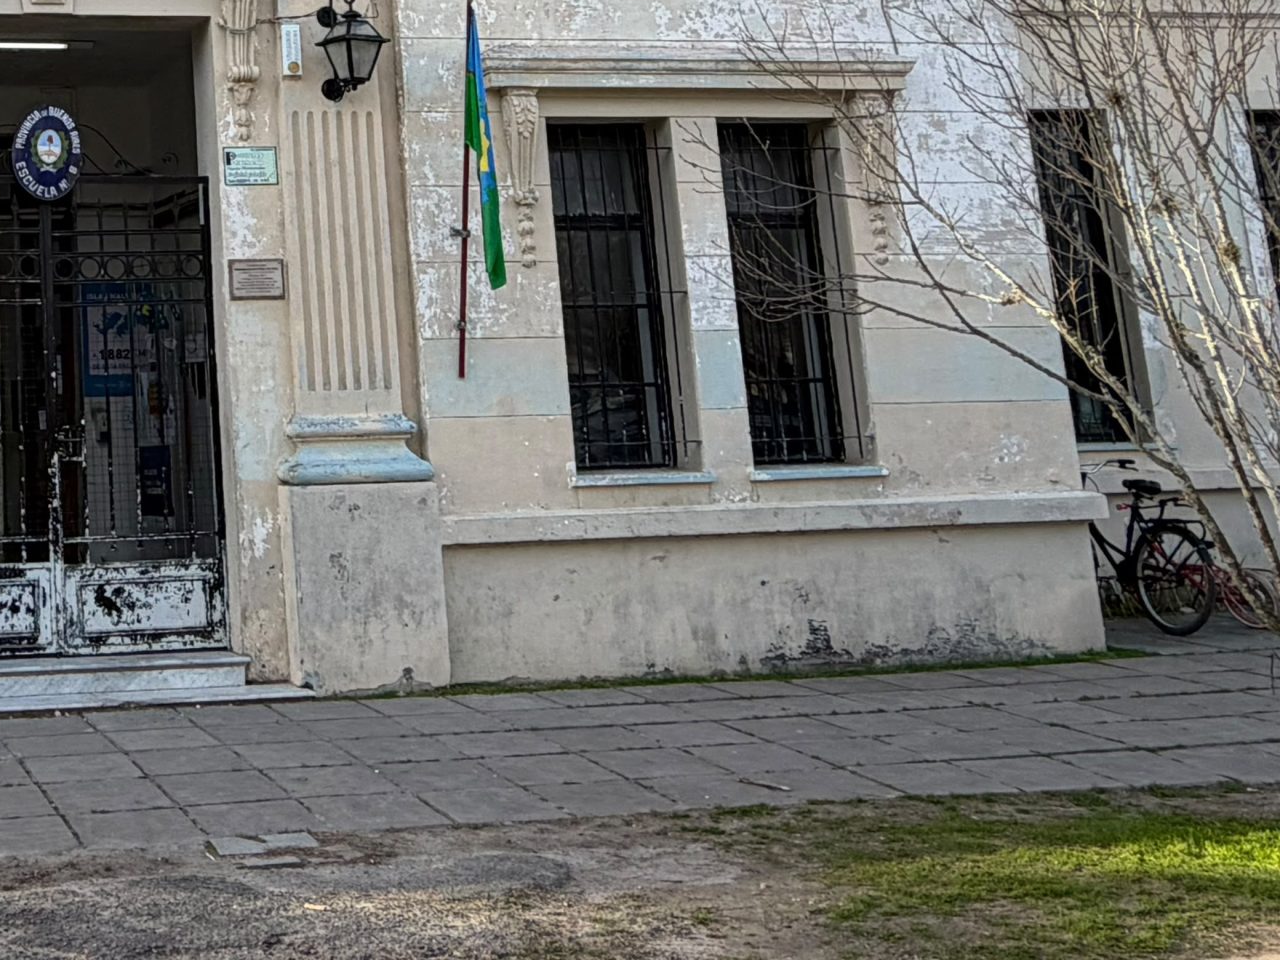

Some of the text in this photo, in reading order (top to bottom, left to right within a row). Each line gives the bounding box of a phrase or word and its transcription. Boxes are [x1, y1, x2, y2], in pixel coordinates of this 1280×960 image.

[15, 110, 41, 149] PROVINCIA
[48, 106, 76, 130] BUENOS
[15, 161, 58, 198] ESCUELA
[99, 348, 130, 360] 1882
